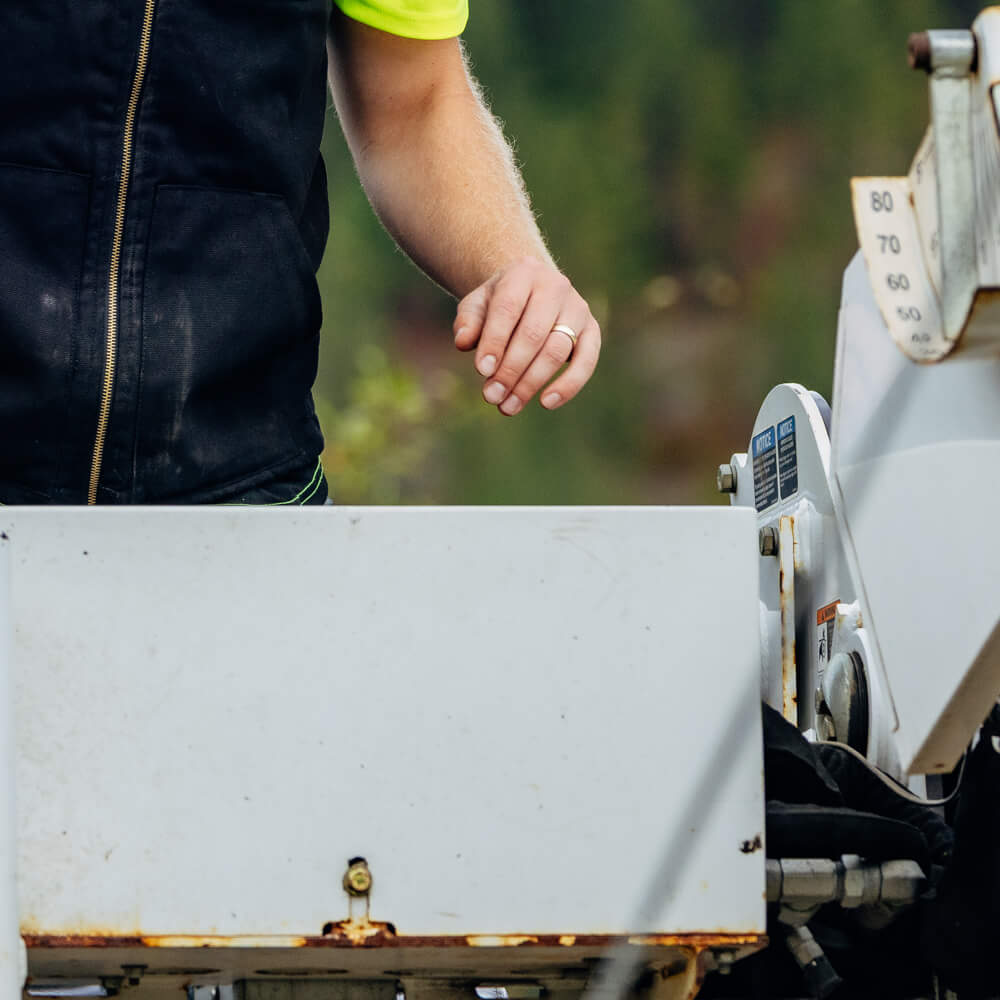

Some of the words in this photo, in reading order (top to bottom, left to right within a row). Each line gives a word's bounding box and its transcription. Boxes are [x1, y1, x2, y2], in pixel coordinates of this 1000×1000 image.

[870, 191, 894, 212] 80
[877, 234, 901, 254] 70
[886, 274, 910, 290] 60
